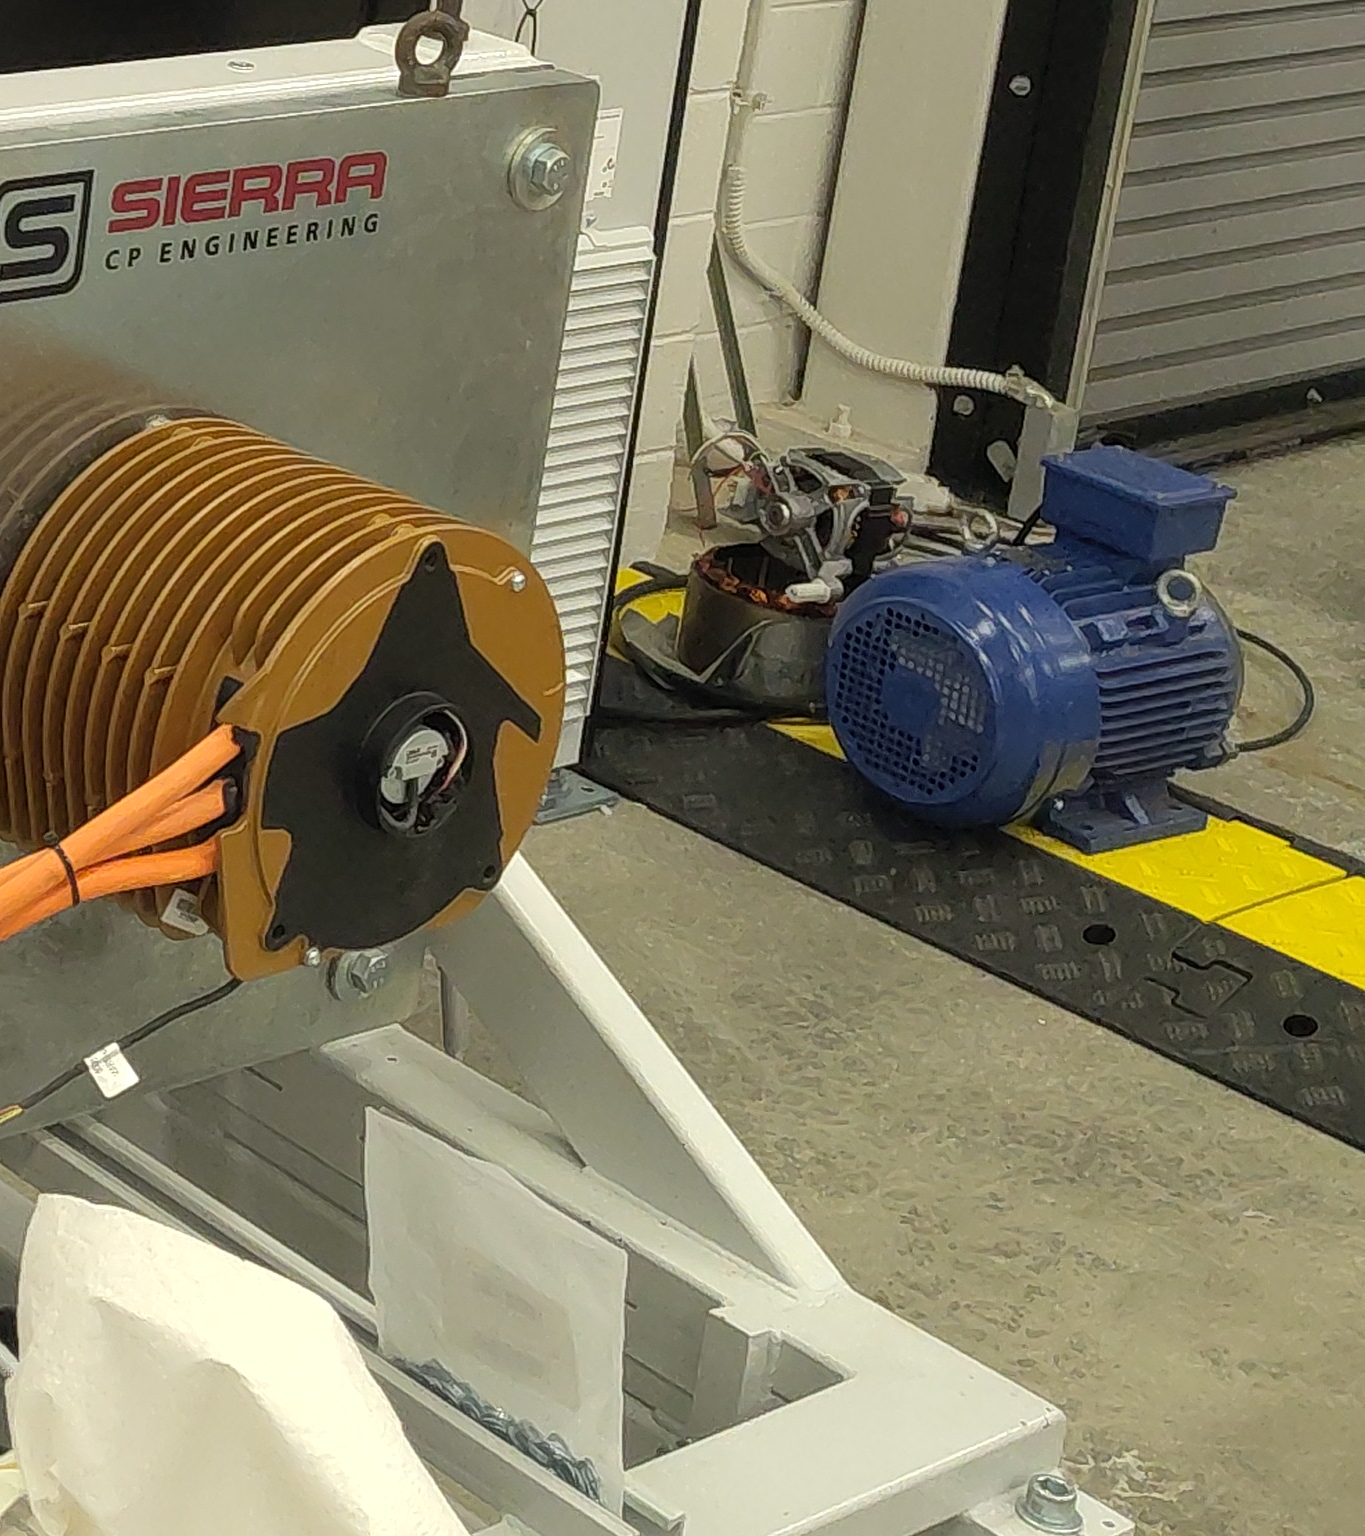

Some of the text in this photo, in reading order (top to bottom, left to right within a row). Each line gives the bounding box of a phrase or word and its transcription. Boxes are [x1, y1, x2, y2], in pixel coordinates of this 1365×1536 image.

[107, 151, 388, 234] SIERRA
[105, 213, 380, 271] CP ENGINEERING
